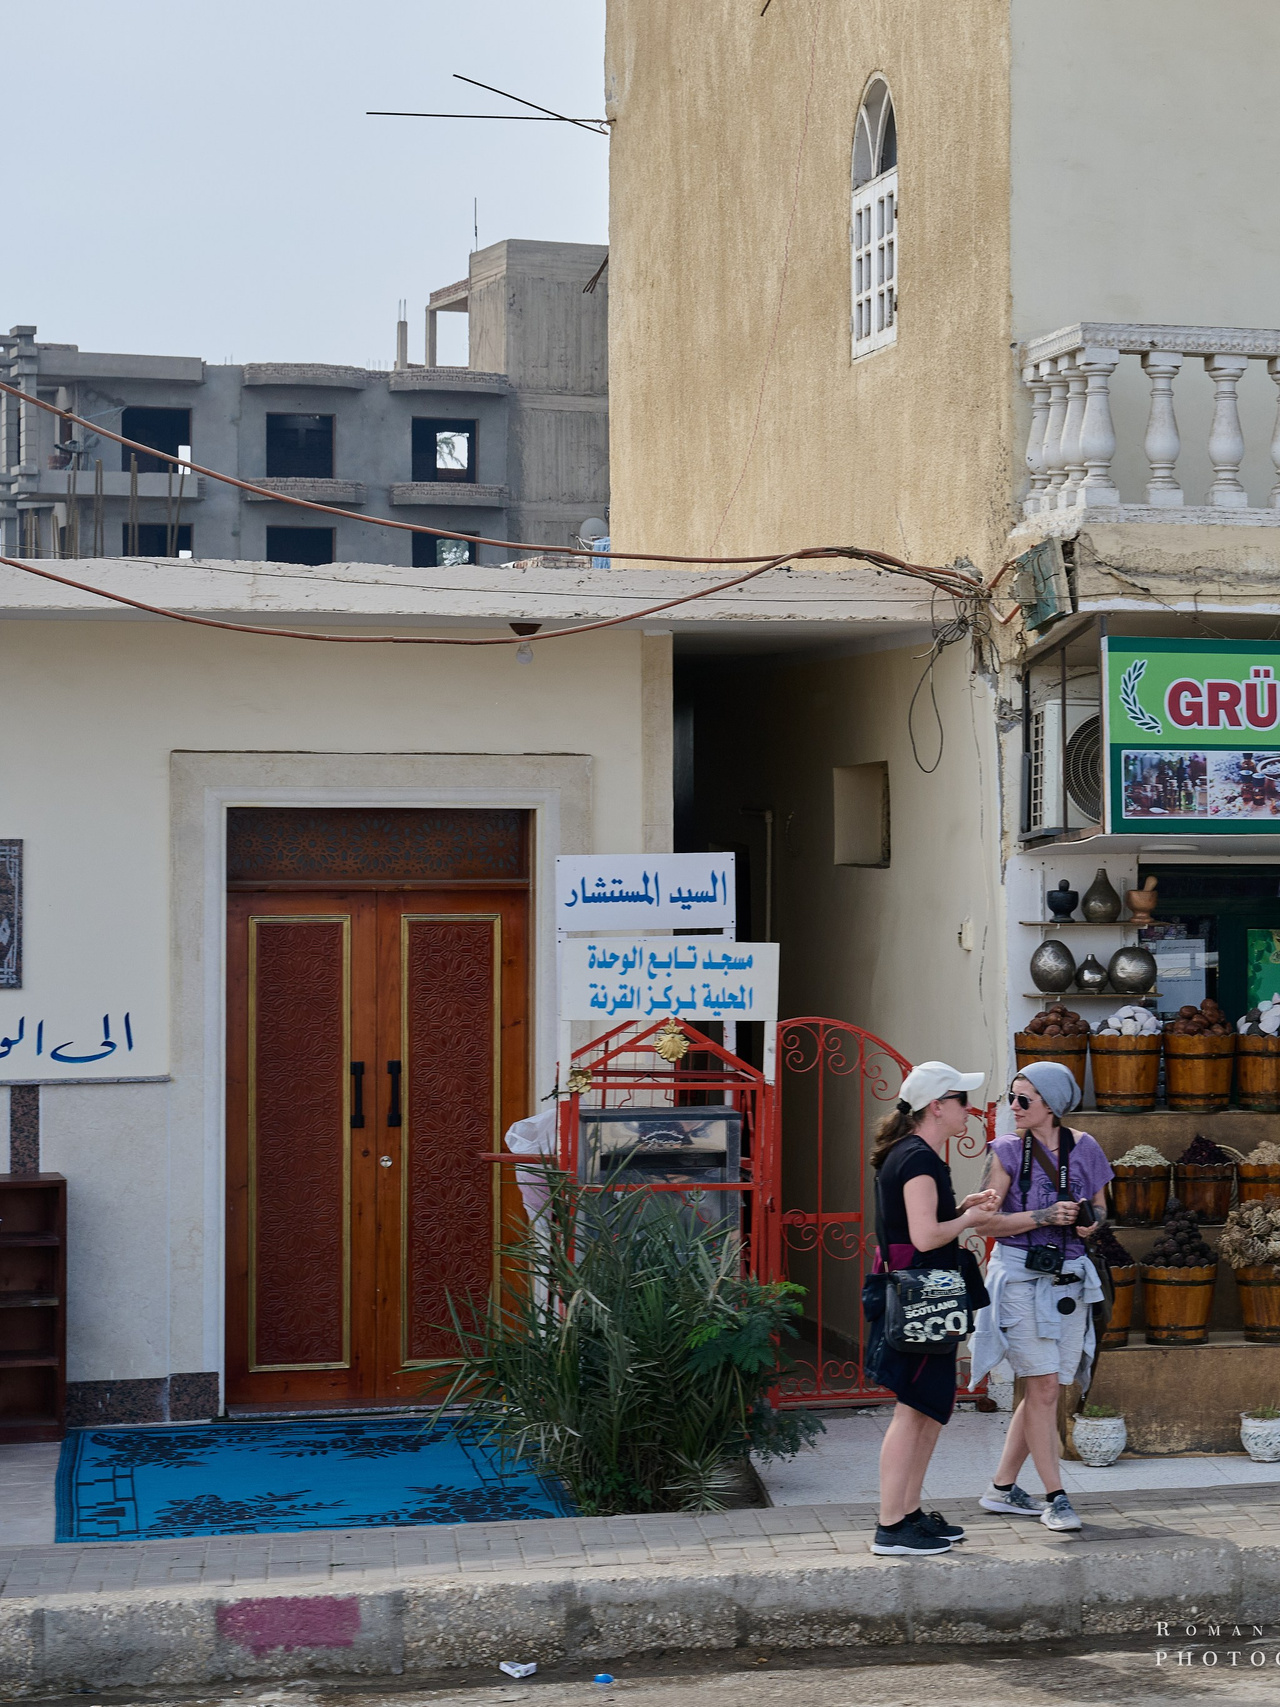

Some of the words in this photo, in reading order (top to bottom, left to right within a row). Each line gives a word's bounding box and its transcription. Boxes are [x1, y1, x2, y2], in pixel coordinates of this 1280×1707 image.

[564, 871, 660, 907] المستشار
[669, 870, 727, 910] السيد
[588, 945, 643, 975] الوحدة
[647, 945, 697, 979] تابع
[702, 949, 753, 976] مسجد
[589, 983, 641, 1016] القرنة
[644, 984, 697, 1016] لمركز
[703, 983, 753, 1016] المحلية
[905, 1300, 958, 1319] SCOTLAND
[903, 1310, 967, 1342] SCO
